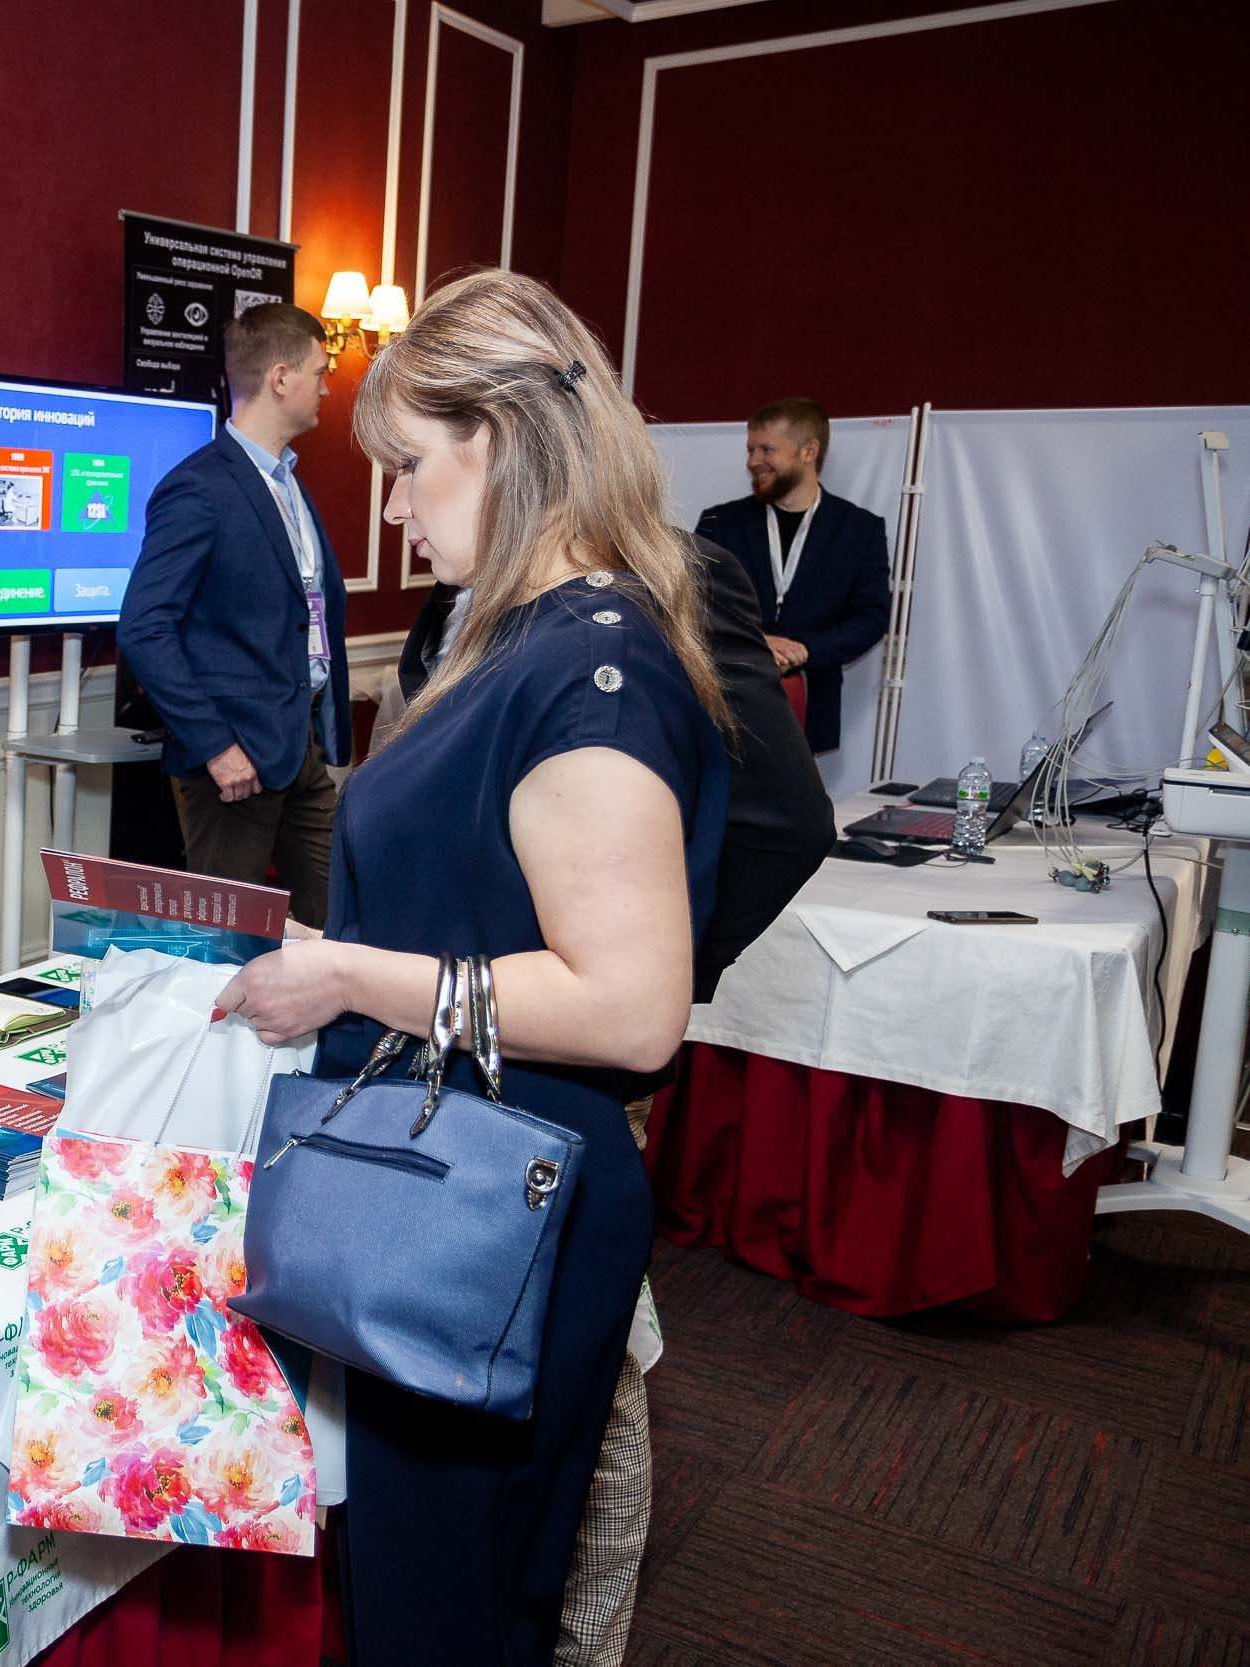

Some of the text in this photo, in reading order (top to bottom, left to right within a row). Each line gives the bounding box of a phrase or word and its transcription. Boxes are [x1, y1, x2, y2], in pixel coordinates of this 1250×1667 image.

[144, 231, 287, 270] Универсальная система управления
[171, 256, 230, 276] операционной
[33, 409, 96, 428] инноваций
[6, 1530, 56, 1593] Р-ФАРМ
[28, 1581, 64, 1613] здоровья
